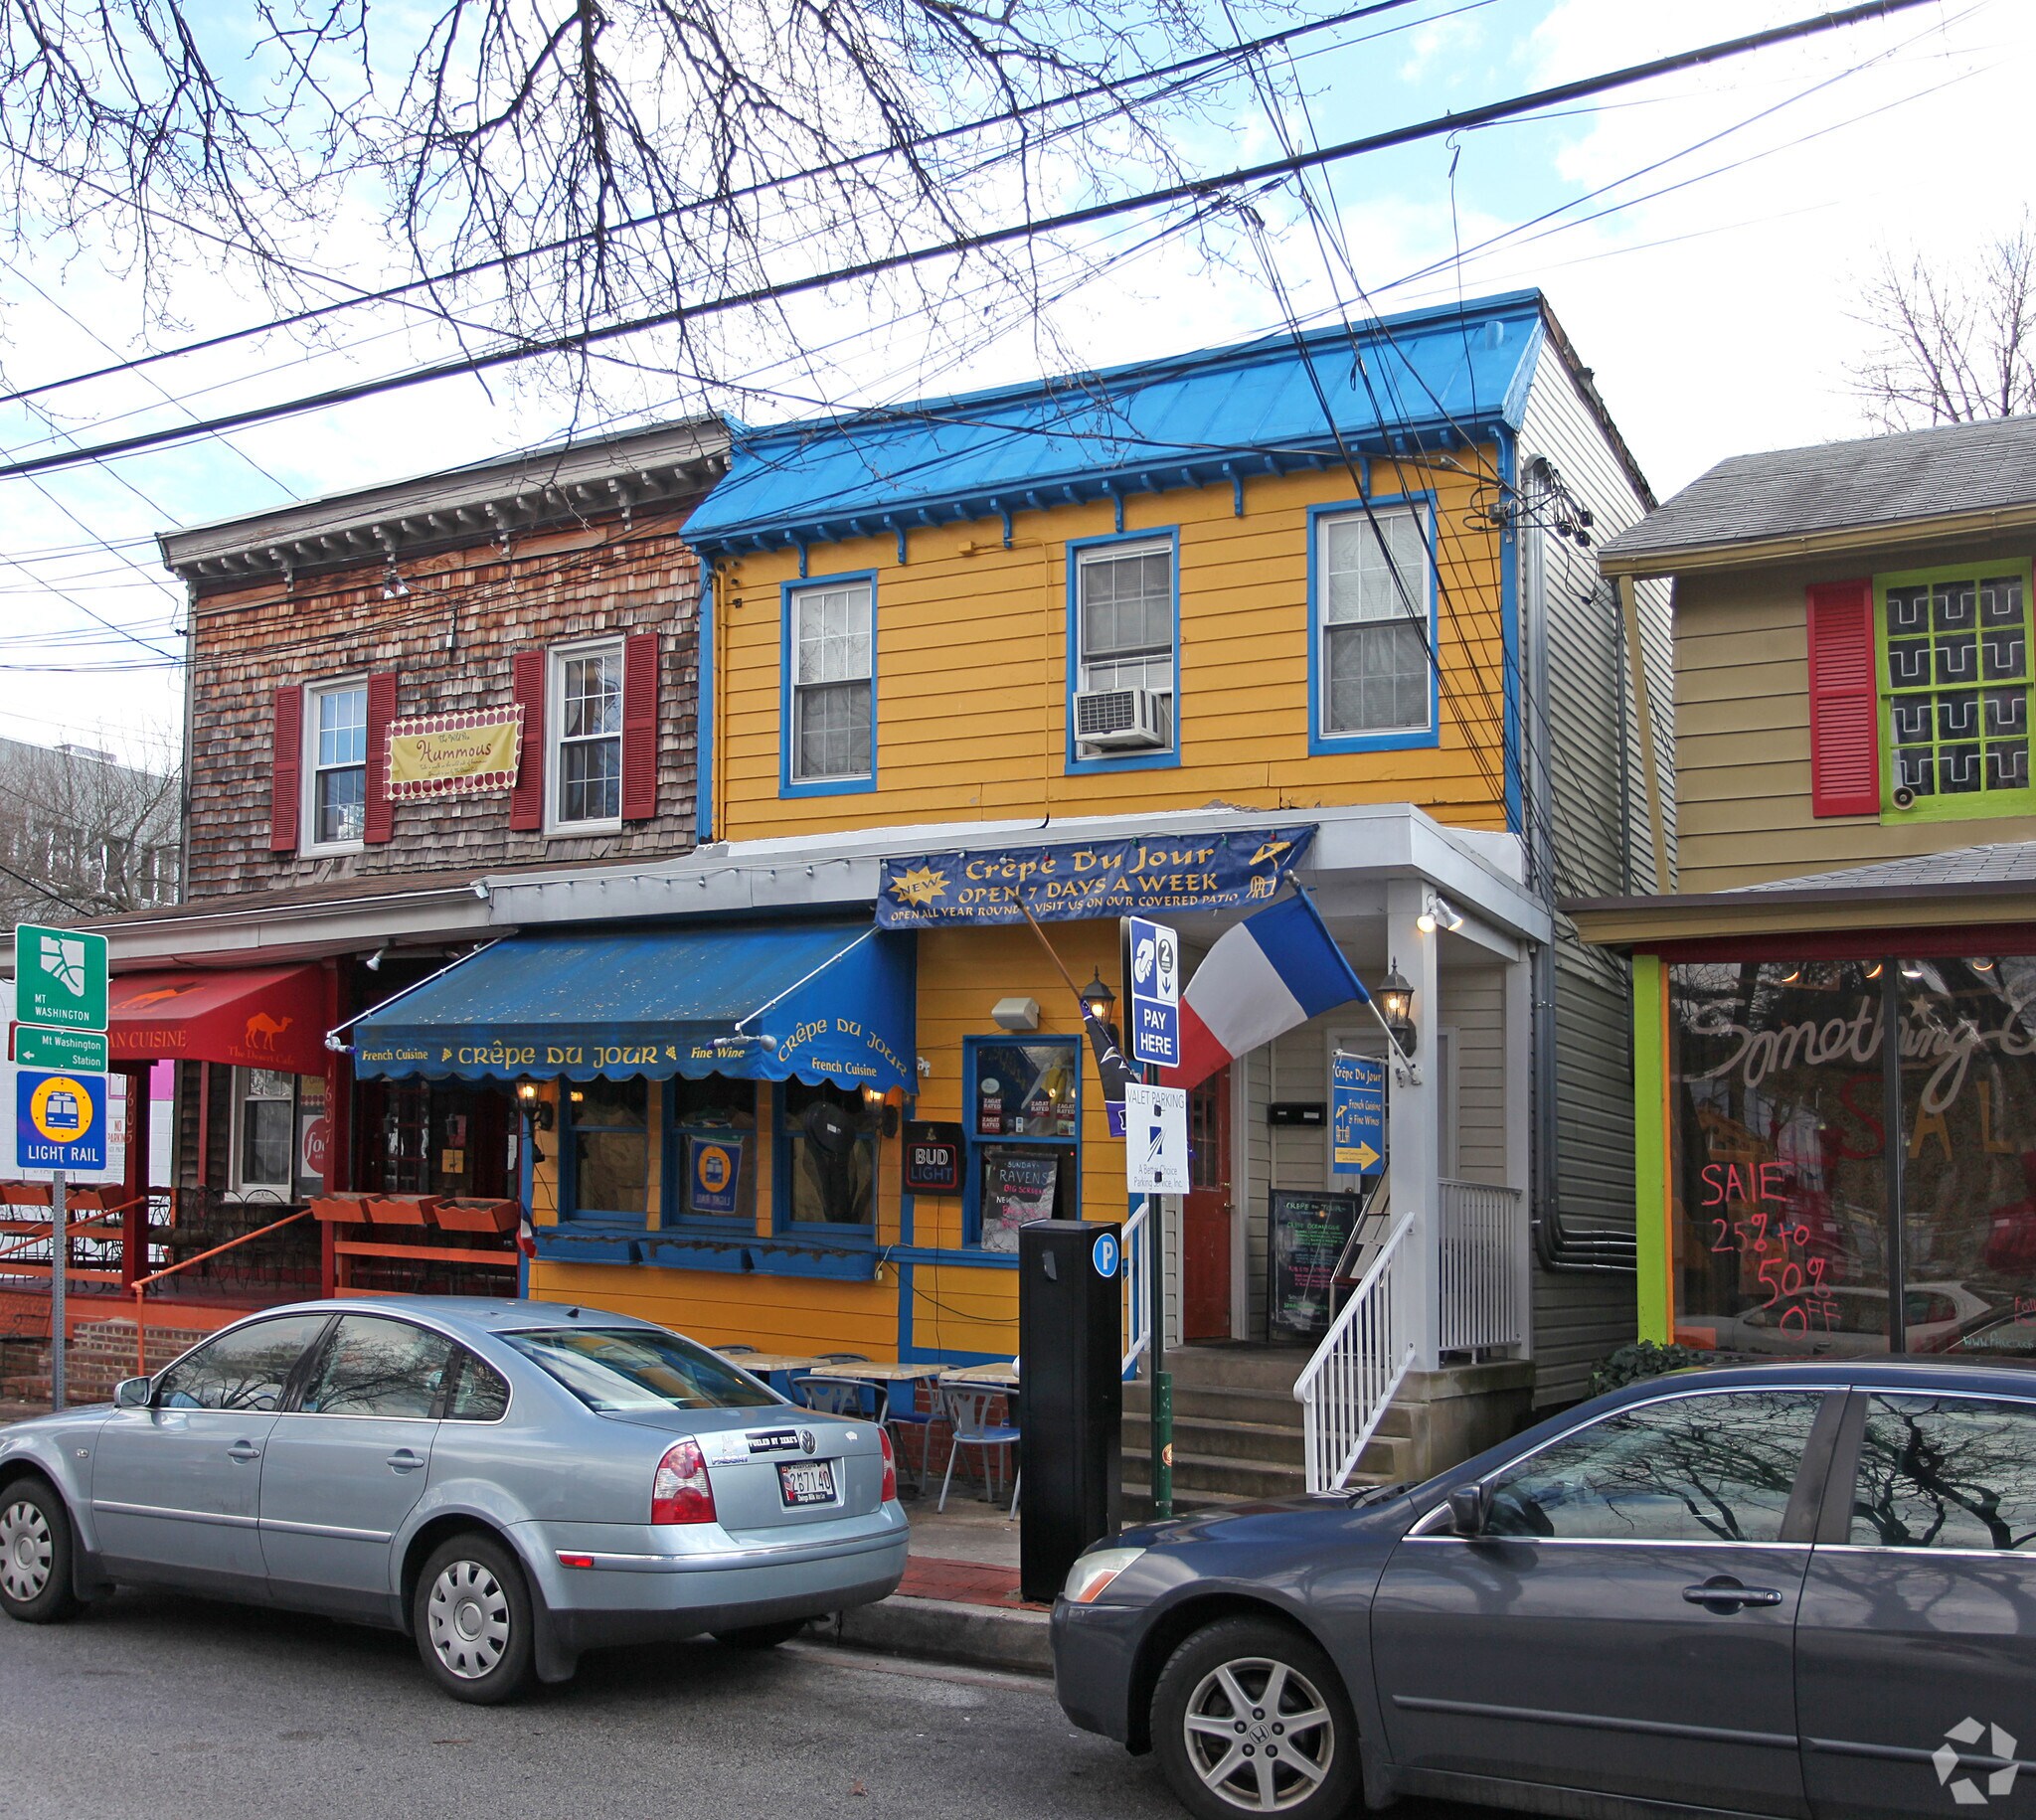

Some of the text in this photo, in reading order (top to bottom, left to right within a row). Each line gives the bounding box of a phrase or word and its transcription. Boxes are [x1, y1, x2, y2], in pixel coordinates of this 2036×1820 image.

[416, 740, 492, 762] Hummous
[965, 846, 1215, 882] Crêpe Du Jour
[899, 877, 939, 897] NEW
[958, 873, 1218, 905] OPEN 7 DAYS A WEEK
[891, 893, 1239, 921] OPEN ALL YEAR ROUND VISIT US ON OUR COVERED PATIO
[1161, 940, 1170, 961] 2
[35, 994, 46, 1004] MT
[35, 1006, 90, 1021] WASHINGTON
[1143, 1008, 1167, 1030] PAY
[836, 1018, 862, 1037] DU
[42, 1036, 53, 1046] Mt
[55, 1037, 101, 1052] Washington
[129, 1030, 187, 1049] CUISINE
[1140, 1032, 1172, 1056] HERE
[73, 1055, 101, 1067] Station
[362, 1049, 428, 1061] French Cuisine
[546, 1047, 583, 1064] DU
[593, 1046, 658, 1069] JOUR
[691, 1046, 746, 1059] Fine Wine
[1671, 994, 1981, 1113] Something
[811, 1057, 877, 1076] French Cuisine
[1334, 1066, 1382, 1084] Crêpe Du Jour
[1127, 1088, 1185, 1109] VALET PARKING
[1349, 1098, 1381, 1111] French Cuisine
[114, 1120, 122, 1132] NO
[1354, 1115, 1364, 1125] Fine
[1365, 1114, 1380, 1126] Wines
[108, 1133, 125, 1143] PARKIN
[28, 1145, 65, 1160] LIGHT
[71, 1147, 99, 1162] RAIL
[915, 1148, 948, 1165] BUD
[911, 1166, 953, 1181] LIGHT
[999, 1169, 1050, 1185] RAVENS
[1138, 1164, 1143, 1174] A
[1160, 1165, 1178, 1176] Choice
[1004, 1184, 1017, 1193] BIG
[1133, 1176, 1153, 1190] Parking
[1711, 1213, 1809, 1252] 25% to
[1103, 1241, 1113, 1270] P
[1758, 1256, 1831, 1308] 50%
[1780, 1298, 1841, 1341] OFF
[711, 1454, 750, 1465] PASSAT
